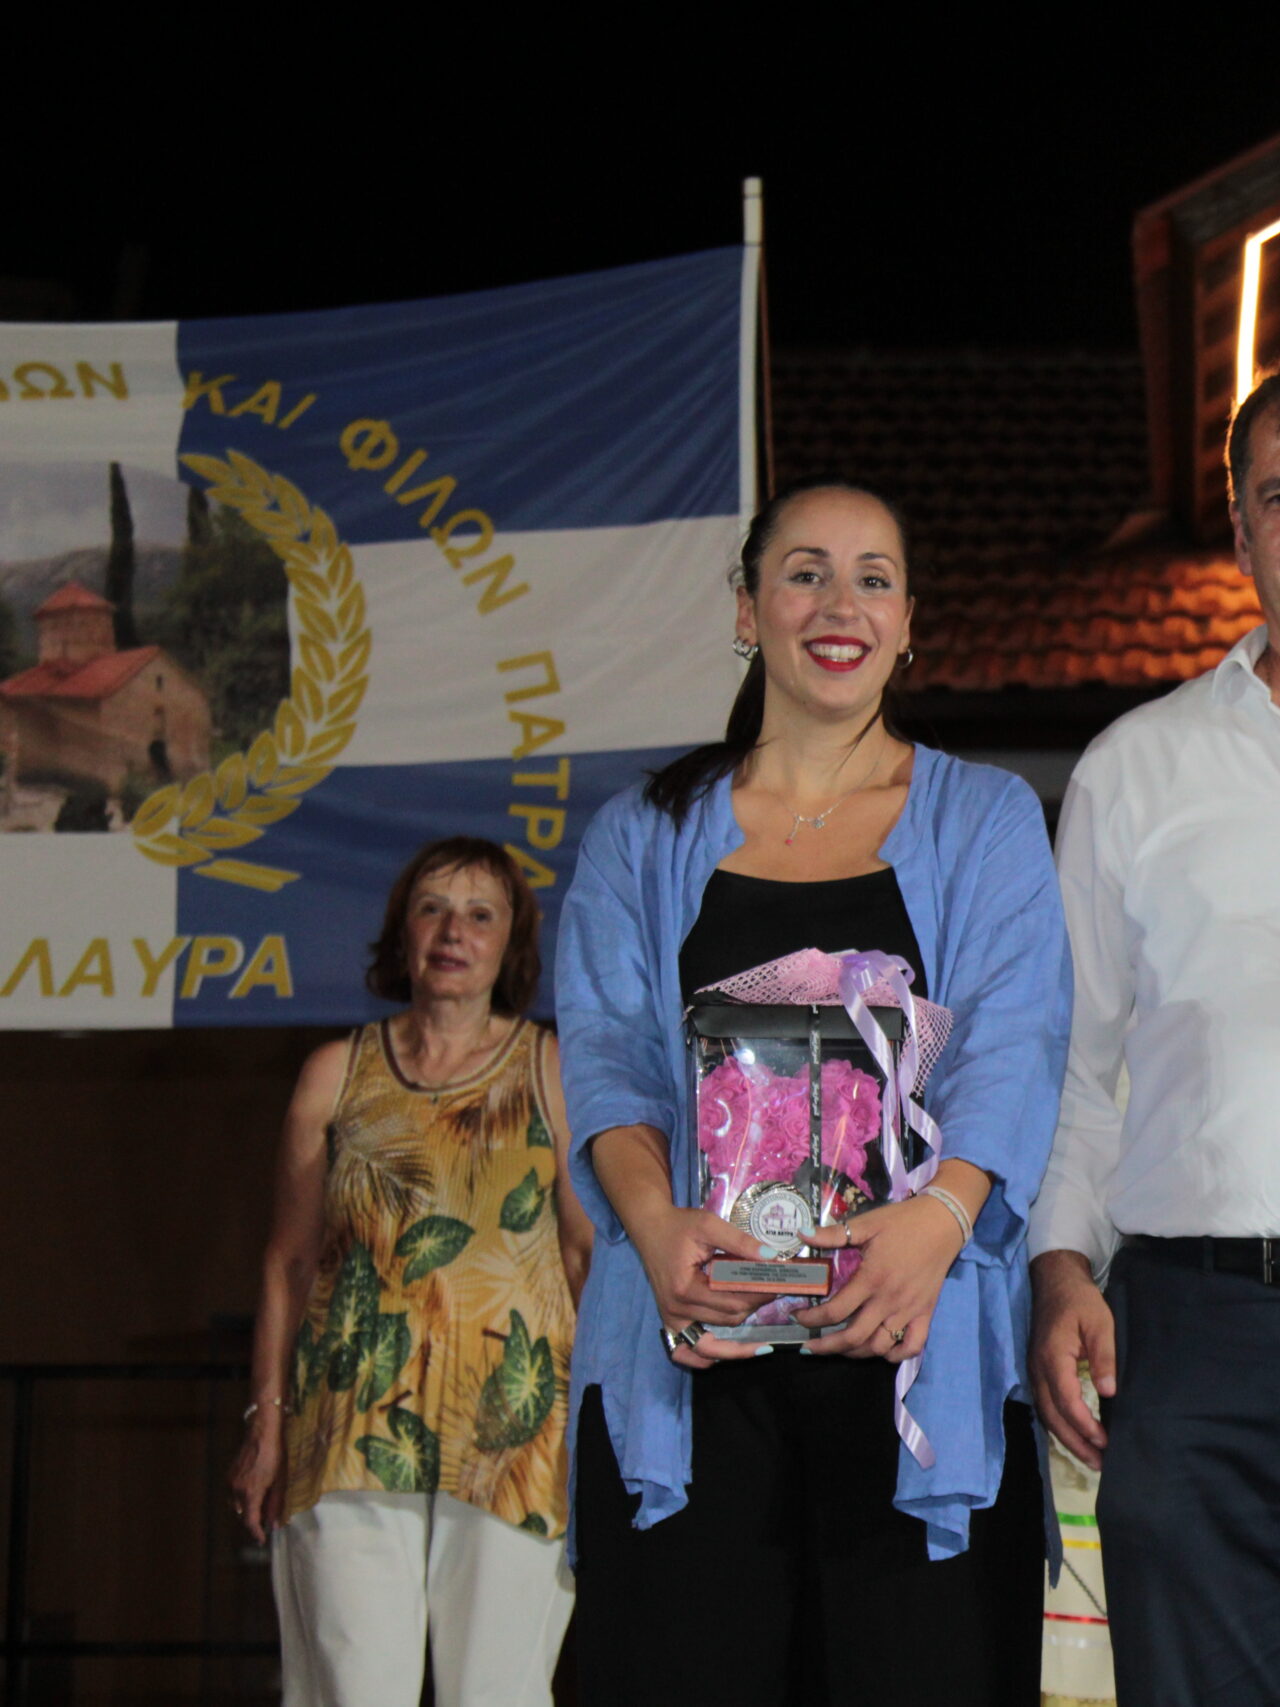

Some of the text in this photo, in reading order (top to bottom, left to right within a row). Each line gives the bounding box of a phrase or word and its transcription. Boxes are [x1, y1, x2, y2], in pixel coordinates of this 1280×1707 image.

[181, 371, 317, 430] ΚΑΙ
[339, 418, 531, 615] ΦΙΛΩΝ
[496, 650, 570, 918] ΠΑΤΡΑ
[0, 935, 294, 998] ΛΑΥΡΑ
